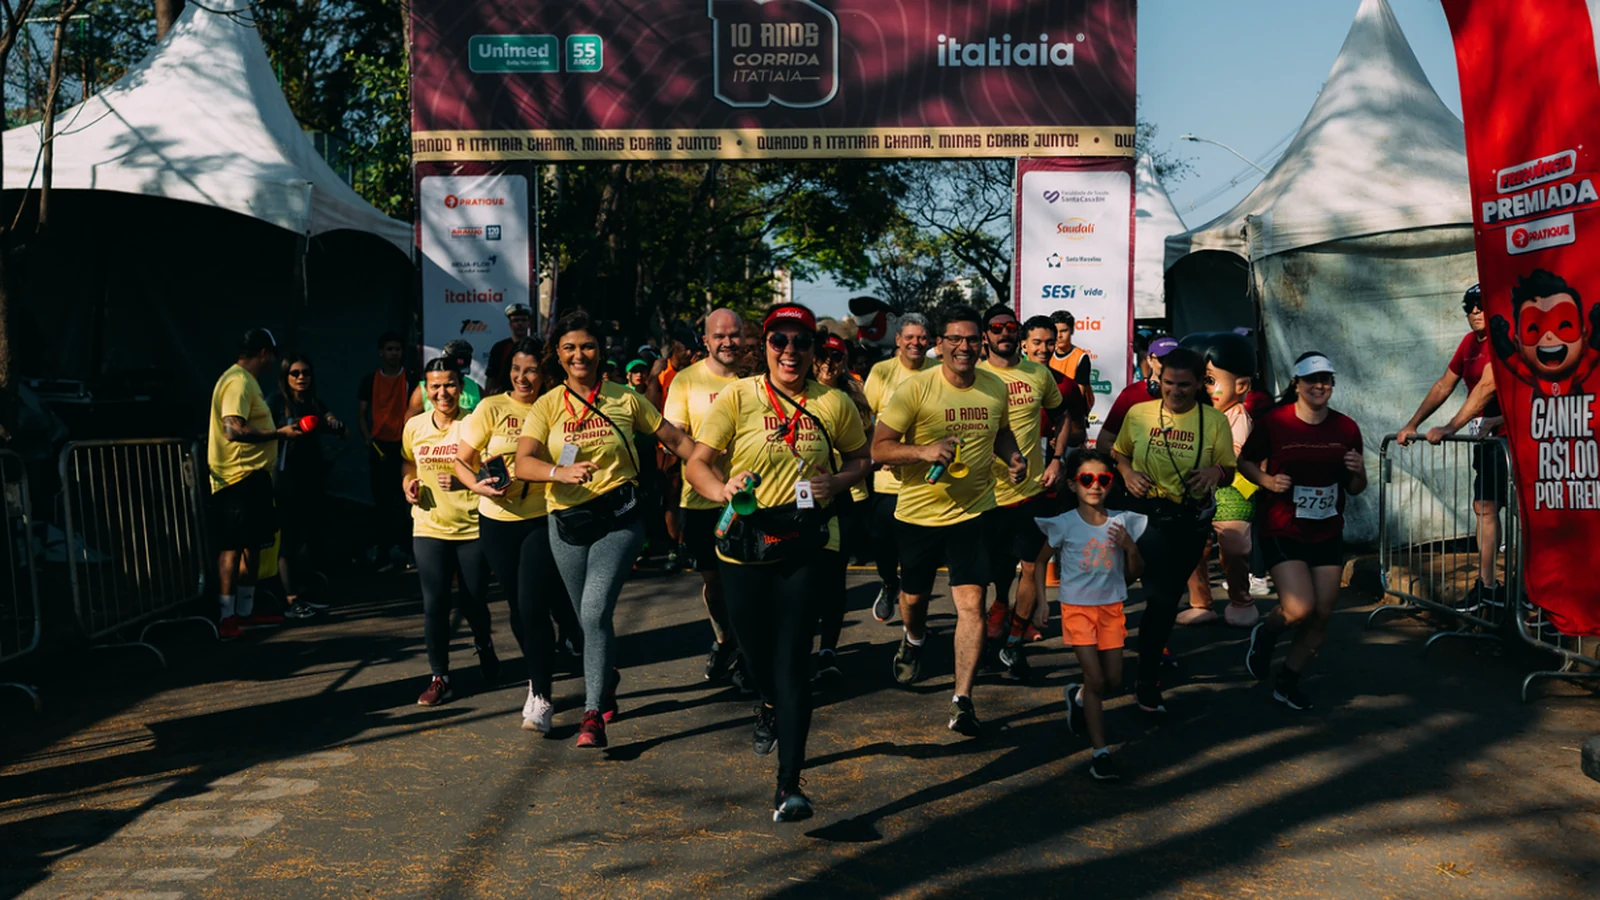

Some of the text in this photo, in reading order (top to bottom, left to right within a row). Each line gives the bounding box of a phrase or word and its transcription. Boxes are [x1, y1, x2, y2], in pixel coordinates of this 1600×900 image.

[731, 22, 819, 47] 10 ANOS
[478, 42, 549, 58] Unimed
[573, 43, 596, 58] 55
[937, 33, 1074, 66] itatiaia
[733, 53, 819, 66] CORRIDA
[733, 70, 802, 82] ITATIAIA
[457, 137, 465, 151] A
[469, 137, 523, 151] ITATIAIA
[527, 136, 577, 151] CHAMA,
[582, 136, 625, 151] MINAS
[629, 136, 672, 151] CORRE
[677, 136, 722, 150] JUNTO!
[757, 135, 808, 150] QUANDO
[813, 135, 821, 149] A
[826, 135, 880, 149] ITATIAIA
[884, 134, 934, 149] CHAMA,
[938, 134, 982, 149] MINAS
[986, 133, 1029, 148] CORRE
[1033, 133, 1079, 148] JUNTO!
[459, 198, 505, 206] PRATIQUE
[1482, 178, 1599, 223] PREMIADA
[1528, 224, 1571, 243] PRATIQUE
[445, 288, 503, 303] itatiaia
[945, 407, 988, 421] 10 ANOS
[1531, 394, 1594, 439] GANHE
[507, 417, 518, 428] 10
[564, 421, 576, 433] 10
[764, 416, 778, 431] 10
[945, 423, 989, 432] CORRIDA
[419, 443, 458, 456] 10 ANOS
[1298, 495, 1335, 510] 2752
[1535, 481, 1564, 510] POR
